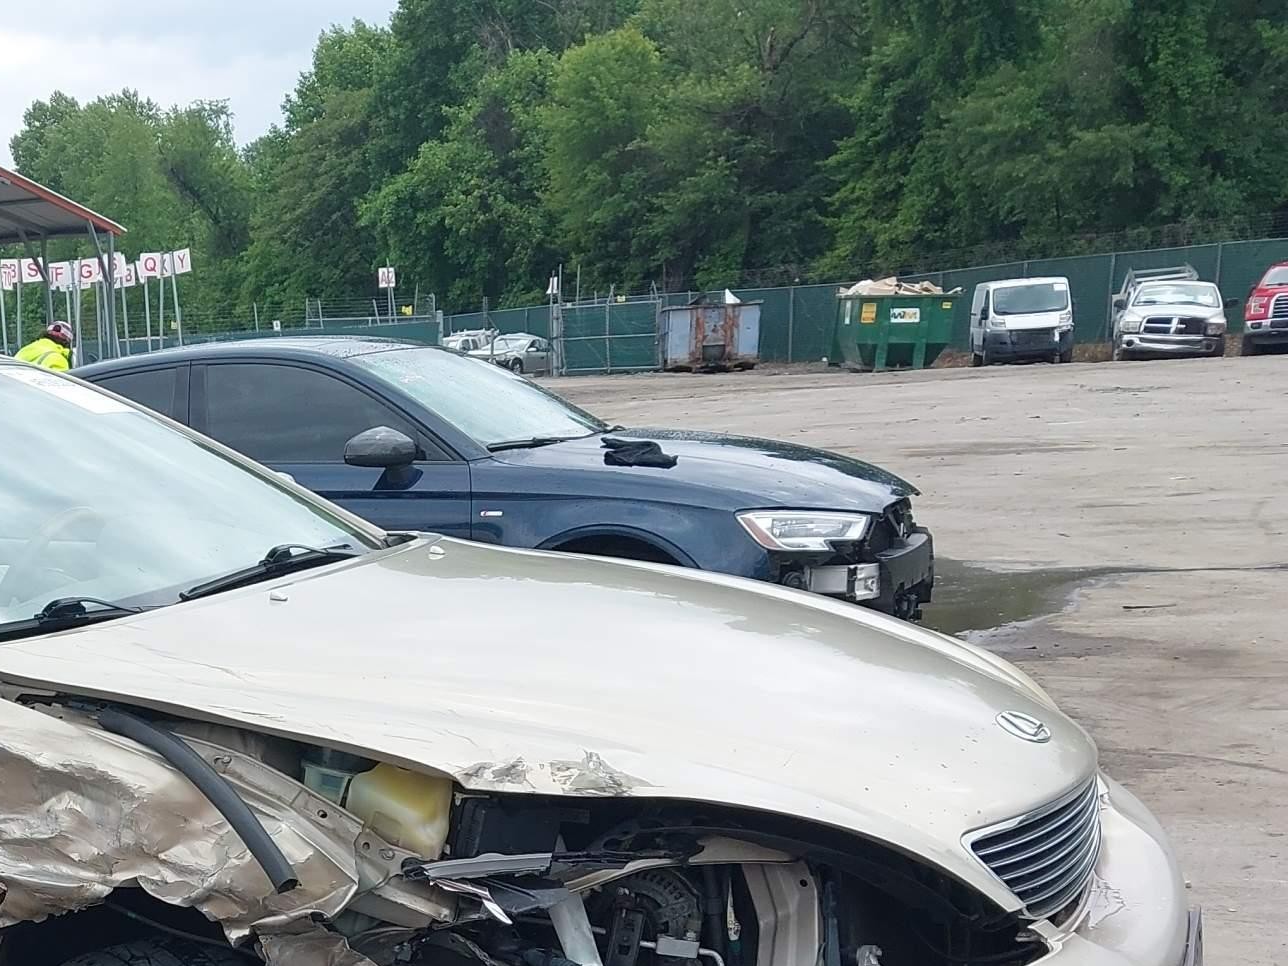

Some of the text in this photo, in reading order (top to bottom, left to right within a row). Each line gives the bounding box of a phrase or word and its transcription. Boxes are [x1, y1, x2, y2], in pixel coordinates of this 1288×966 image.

[144, 257, 156, 272] Q
[177, 253, 186, 269] Y
[27, 262, 39, 277] S
[80, 264, 92, 279] G
